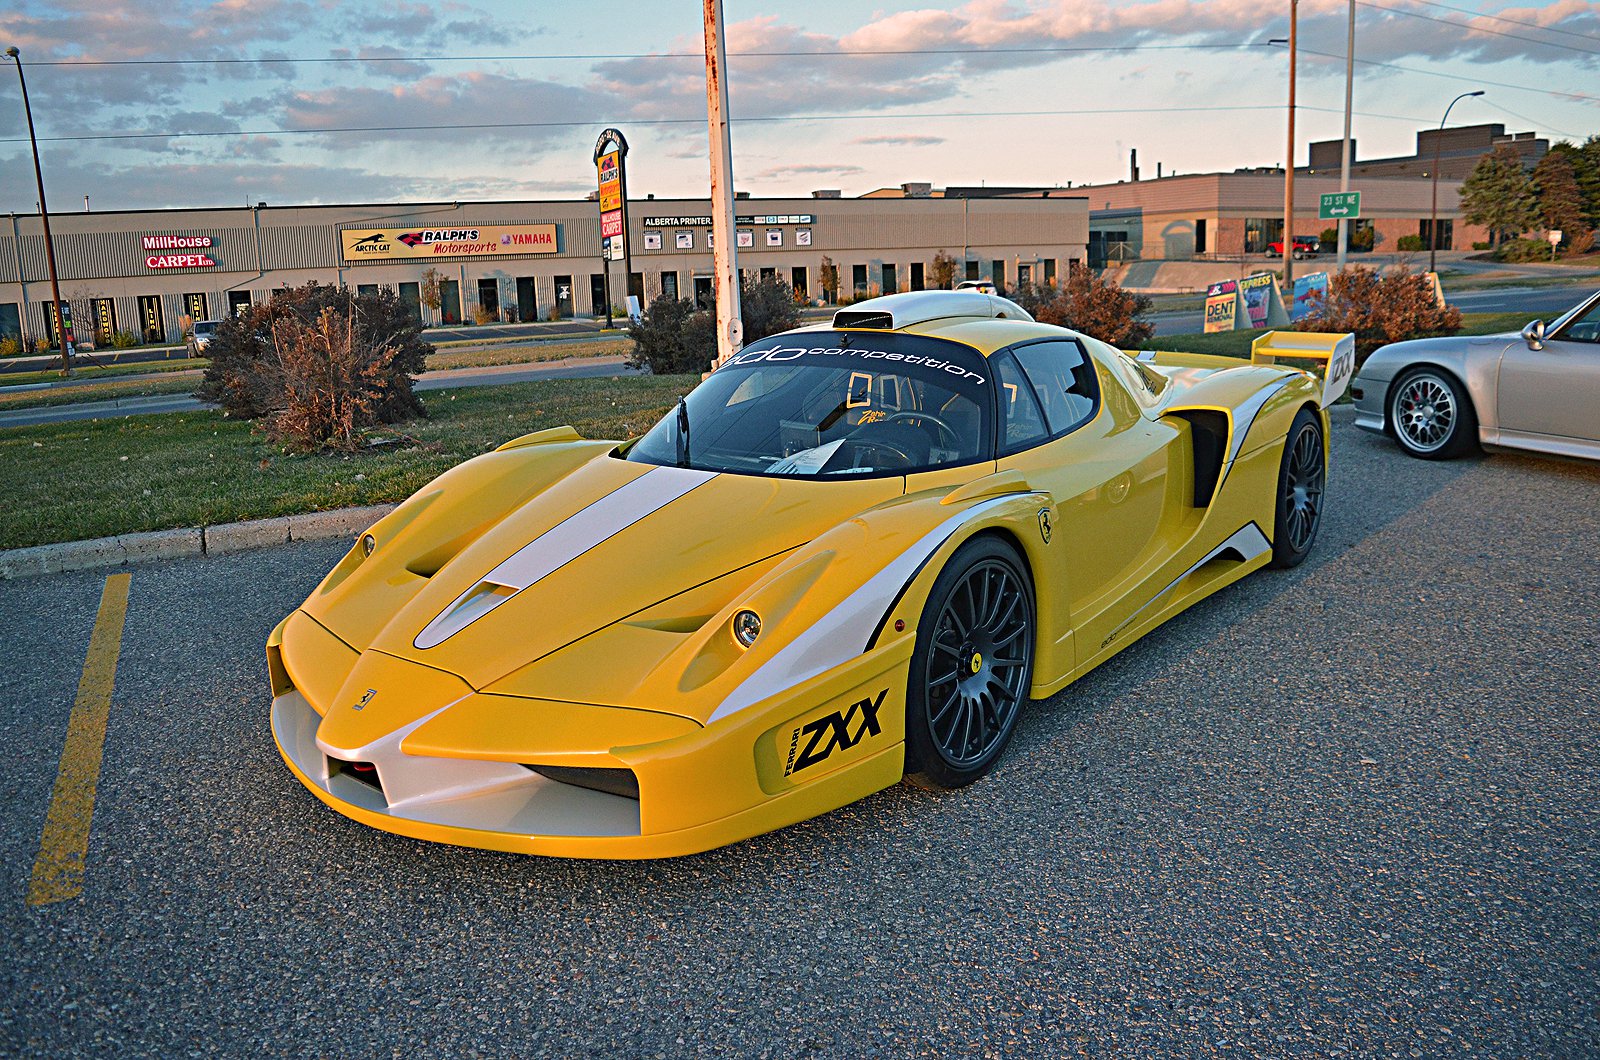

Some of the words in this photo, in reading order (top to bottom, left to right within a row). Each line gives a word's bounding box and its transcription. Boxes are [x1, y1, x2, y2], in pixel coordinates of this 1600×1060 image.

[1324, 197, 1333, 206] 23
[1335, 196, 1344, 205] ST
[1347, 195, 1356, 204] NE
[602, 221, 621, 235] CARPET
[645, 217, 680, 226] ALBERTA
[144, 236, 211, 249] MillHouse
[424, 230, 479, 241] RALPH'S
[512, 233, 552, 245] YAMAHA
[355, 244, 377, 252] ARCTIC
[434, 241, 496, 254] Motorsports
[146, 254, 204, 268] CARPET
[1241, 275, 1271, 290] EXPRESS
[1207, 301, 1235, 317] DENT
[148, 308, 156, 330] LINO
[807, 347, 986, 385] competition
[1333, 350, 1353, 384] ZXX
[792, 688, 889, 773] ZXX
[784, 727, 800, 777] FERRARI
